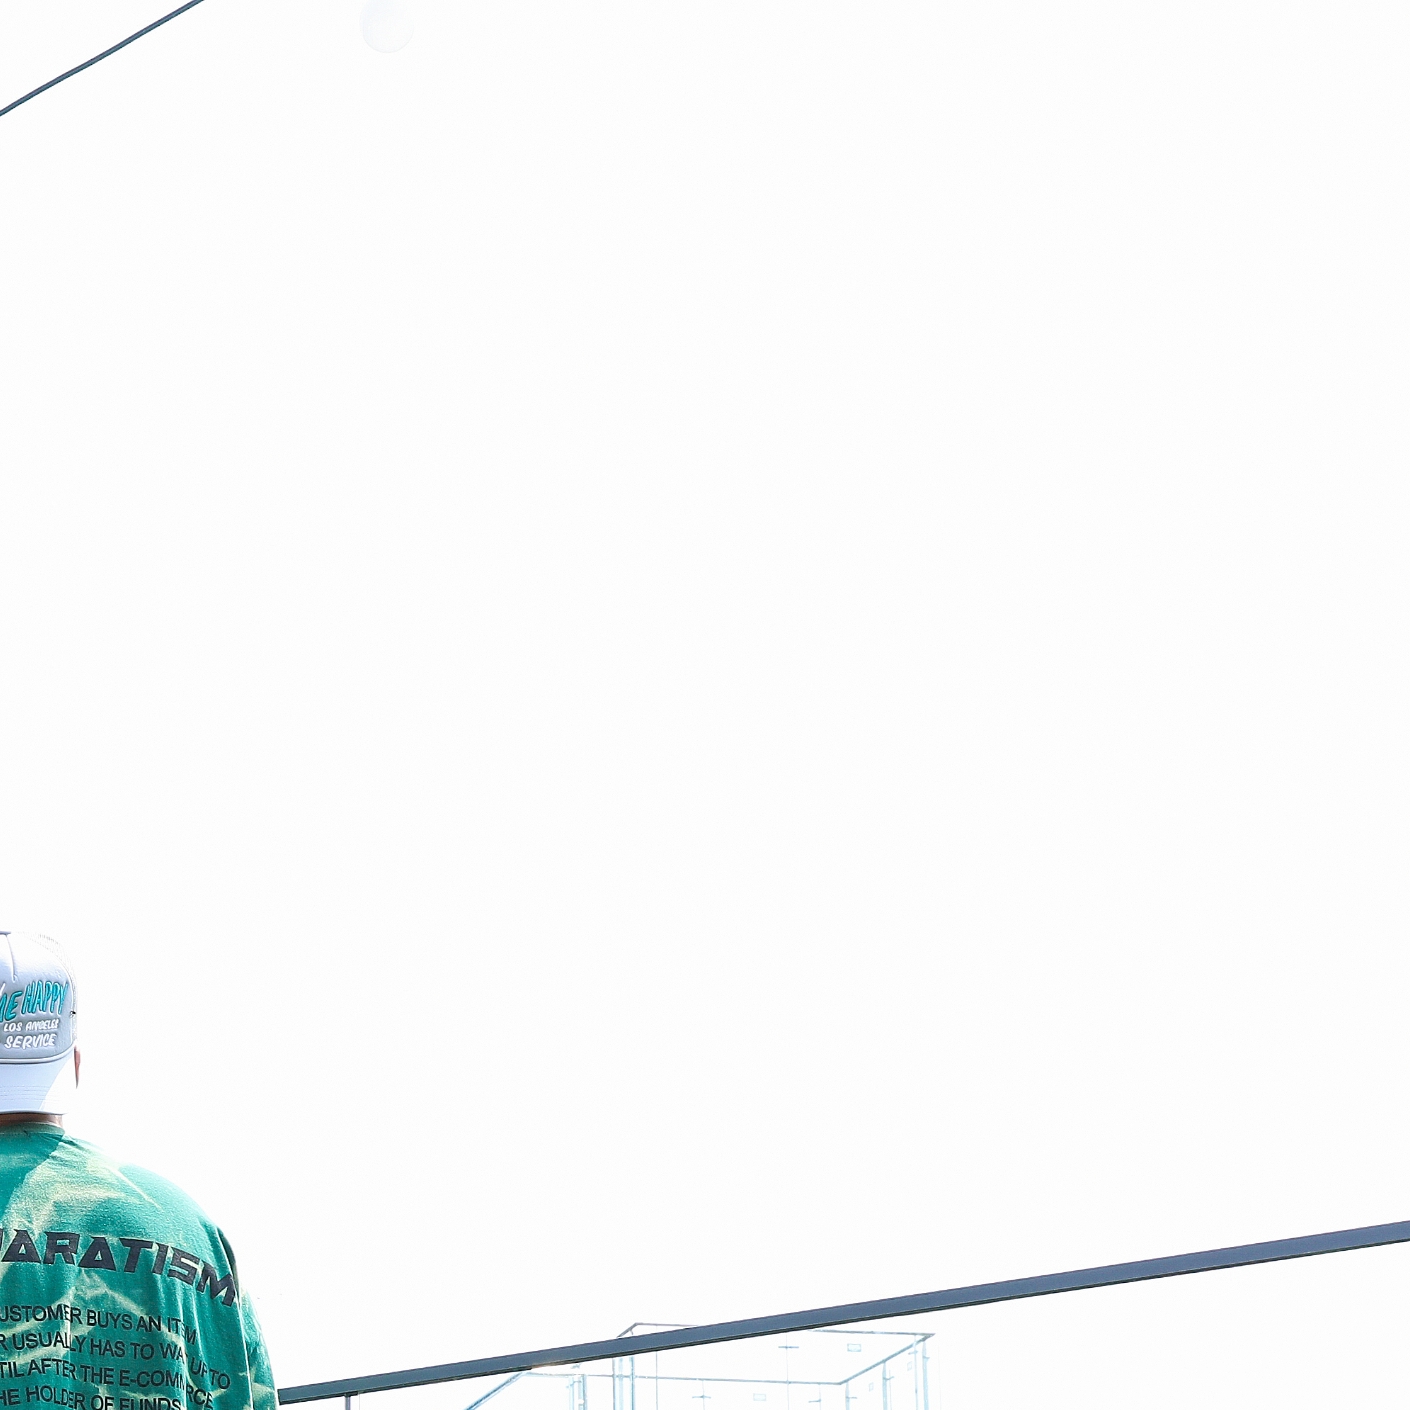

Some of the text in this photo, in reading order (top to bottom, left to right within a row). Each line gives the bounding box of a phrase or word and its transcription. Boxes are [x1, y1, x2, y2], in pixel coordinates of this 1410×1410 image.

[21, 980, 69, 1015] HAPPY
[3, 1022, 22, 1031] LOS
[4, 1034, 57, 1049] SERVICE
[87, 1309, 132, 1330] BUYS
[136, 1315, 161, 1332] AN
[12, 1331, 87, 1353] USUALLY
[90, 1338, 126, 1357] HAS
[130, 1342, 154, 1360] TO
[209, 1369, 231, 1389] TO
[27, 1358, 77, 1381] AFTER
[80, 1365, 114, 1385] THE
[26, 1385, 86, 1410] HOLDER
